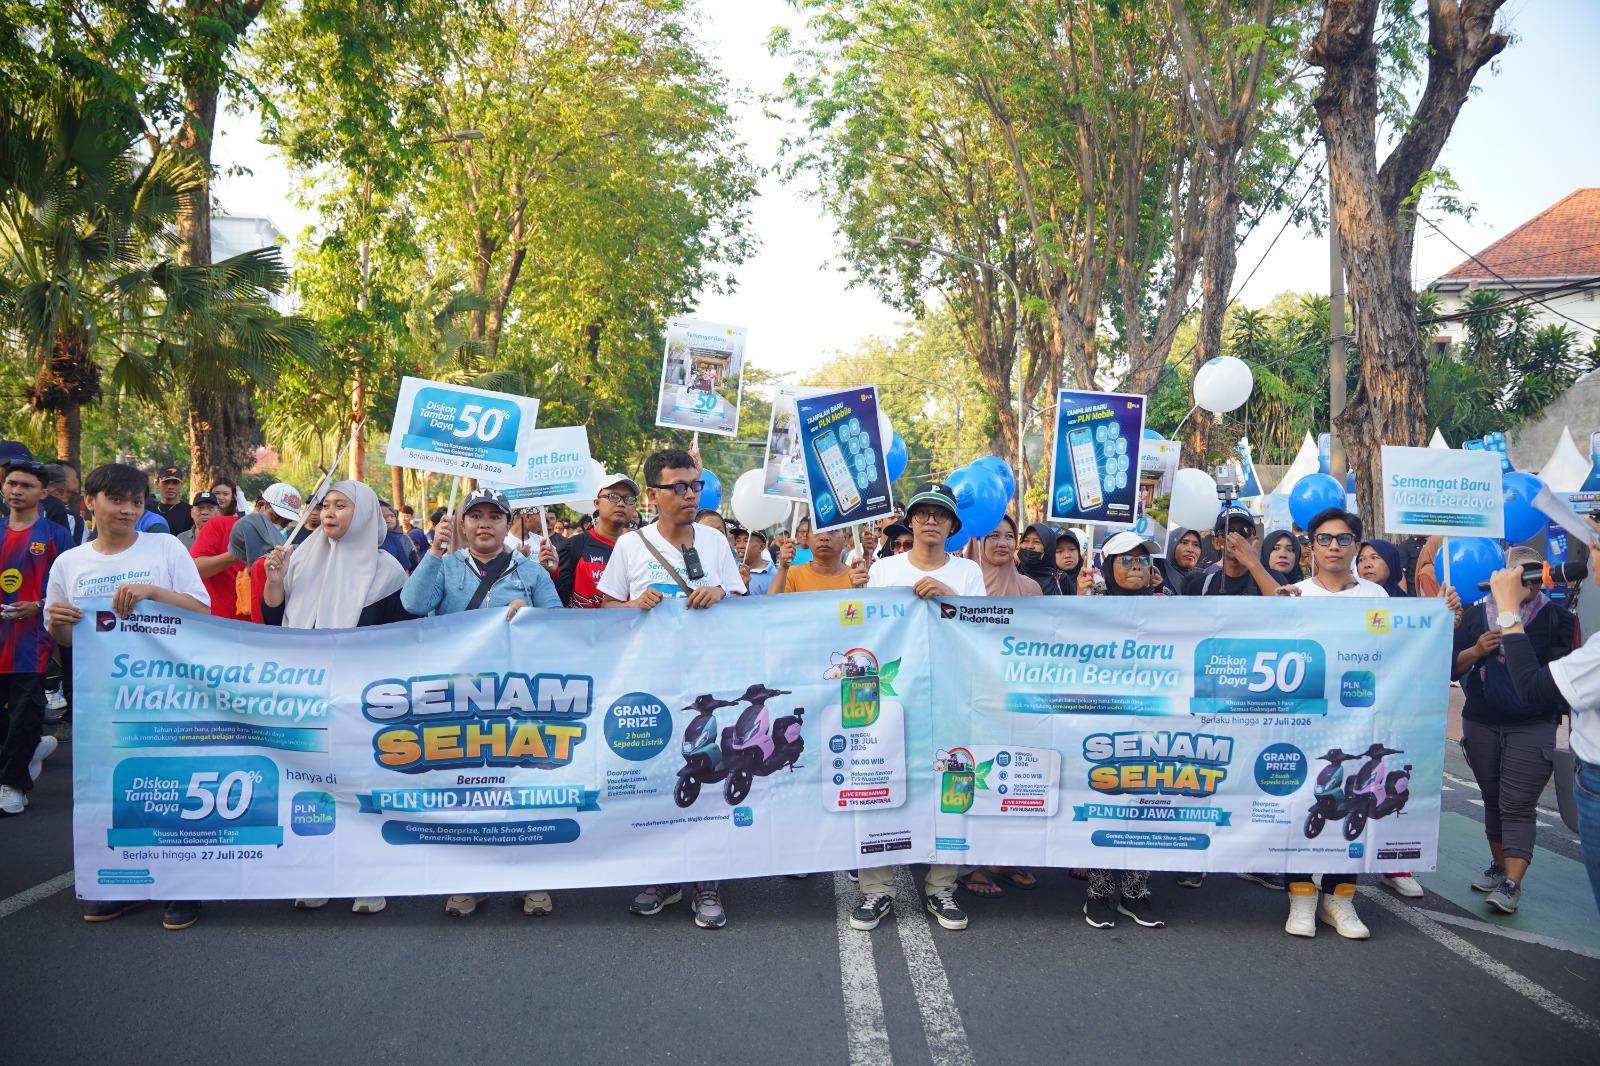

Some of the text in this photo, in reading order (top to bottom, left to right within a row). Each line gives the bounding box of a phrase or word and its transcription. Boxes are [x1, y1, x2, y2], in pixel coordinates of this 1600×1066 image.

[695, 391, 717, 410] 50
[426, 401, 457, 414] Diskon
[831, 402, 844, 413] BARU
[1067, 404, 1108, 416] TAMPILAN BARU
[420, 408, 455, 422] Tambah
[818, 407, 852, 428] PLN Mobile
[1077, 414, 1091, 423] PLN
[1092, 410, 1115, 420] Mobile
[430, 419, 454, 432] Daya
[409, 451, 434, 462] Berlaku
[435, 455, 458, 466] hingga
[484, 465, 502, 473] 2026
[551, 452, 579, 464] Baru
[532, 466, 584, 481] Berdaya
[1392, 474, 1490, 492] Semangat Baru
[471, 489, 502, 500] NY
[1394, 491, 1495, 511] Makin Berdaya
[1569, 494, 1594, 502] SENAM
[79, 573, 126, 587] Semangat
[128, 571, 150, 579] Baru
[78, 584, 111, 596] Makin
[866, 604, 905, 618] PLN
[960, 606, 1014, 615] Danantara
[960, 614, 1010, 625] Indonesia
[1393, 616, 1432, 629] PLN
[121, 622, 177, 635] Indonesia
[1001, 636, 1174, 663] Semangat Baru
[1210, 655, 1247, 665] Diskon
[1338, 651, 1382, 663] hanya di
[111, 654, 326, 688] Semangat Baru
[1004, 661, 1180, 691] Makin Berdaya
[1204, 665, 1247, 675] Tambah
[1248, 652, 1312, 693] 50%
[1219, 675, 1247, 687] Daya
[1343, 681, 1360, 689] PLN
[366, 678, 589, 719] SENAM
[856, 690, 878, 701] free
[1343, 689, 1373, 698] mobile
[114, 684, 329, 723] Makin Berdaya
[844, 691, 877, 724] day
[614, 704, 662, 717] GRAND
[618, 717, 657, 729] PRIZE
[1201, 716, 1230, 724] Berlaku
[1232, 717, 1259, 726] hingga
[1275, 717, 1290, 725] Juli
[212, 733, 234, 741] belajar
[631, 731, 650, 739] buah
[377, 723, 583, 765] SEHAT
[613, 737, 664, 750] Sepeda Listrik
[1085, 735, 1231, 762] SENAM
[1263, 753, 1300, 761] GRAND
[1266, 762, 1296, 771] PRIZE
[286, 768, 337, 784] hanya di
[457, 775, 506, 785] Bersama
[1091, 765, 1224, 792] SEHAT
[133, 777, 179, 789] Diskon
[125, 789, 179, 802] Tambah
[180, 770, 263, 821] 50%
[380, 789, 580, 808] PLN UID JAWA TIMUR
[943, 782, 971, 812] day
[144, 801, 179, 816] Daya
[295, 805, 316, 814] PLN
[1088, 806, 1219, 820] PLN UID JAWA TIMUR
[295, 814, 333, 824] mobile
[406, 825, 435, 834] Games,
[437, 827, 480, 835] Doorprize,
[500, 826, 525, 834] Show,
[527, 824, 556, 832] Senam
[183, 837, 218, 846] Golongan
[419, 834, 543, 843] Pemeriksaan Kesehatan Gratis
[123, 850, 263, 862] Berlaku hingga 27 Juli 2026
